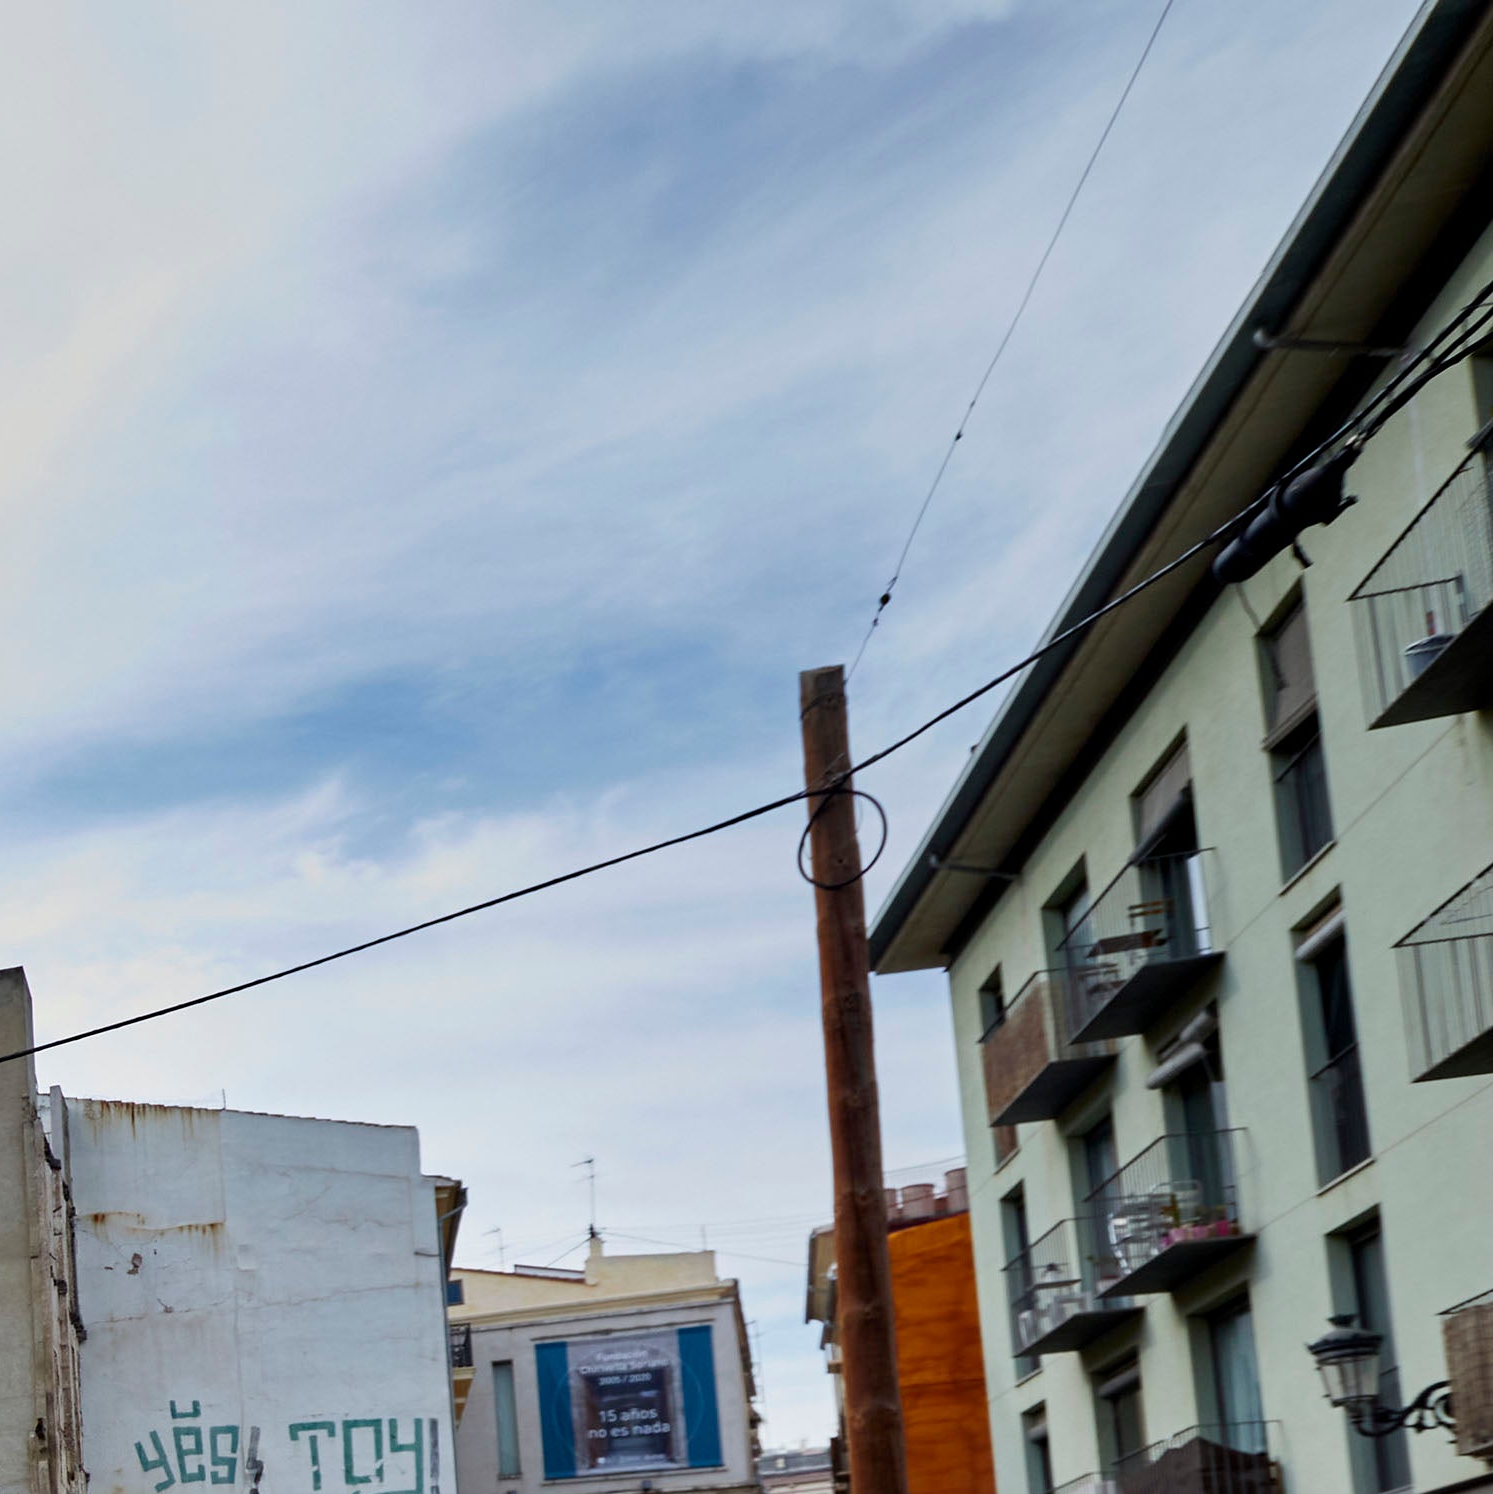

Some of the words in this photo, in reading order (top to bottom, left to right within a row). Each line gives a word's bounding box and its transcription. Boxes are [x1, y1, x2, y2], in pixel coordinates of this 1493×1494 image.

[599, 1410, 617, 1422] 15
[619, 1407, 658, 1422] años
[588, 1428, 607, 1440] no
[610, 1425, 629, 1437] es
[631, 1421, 671, 1436] nada
